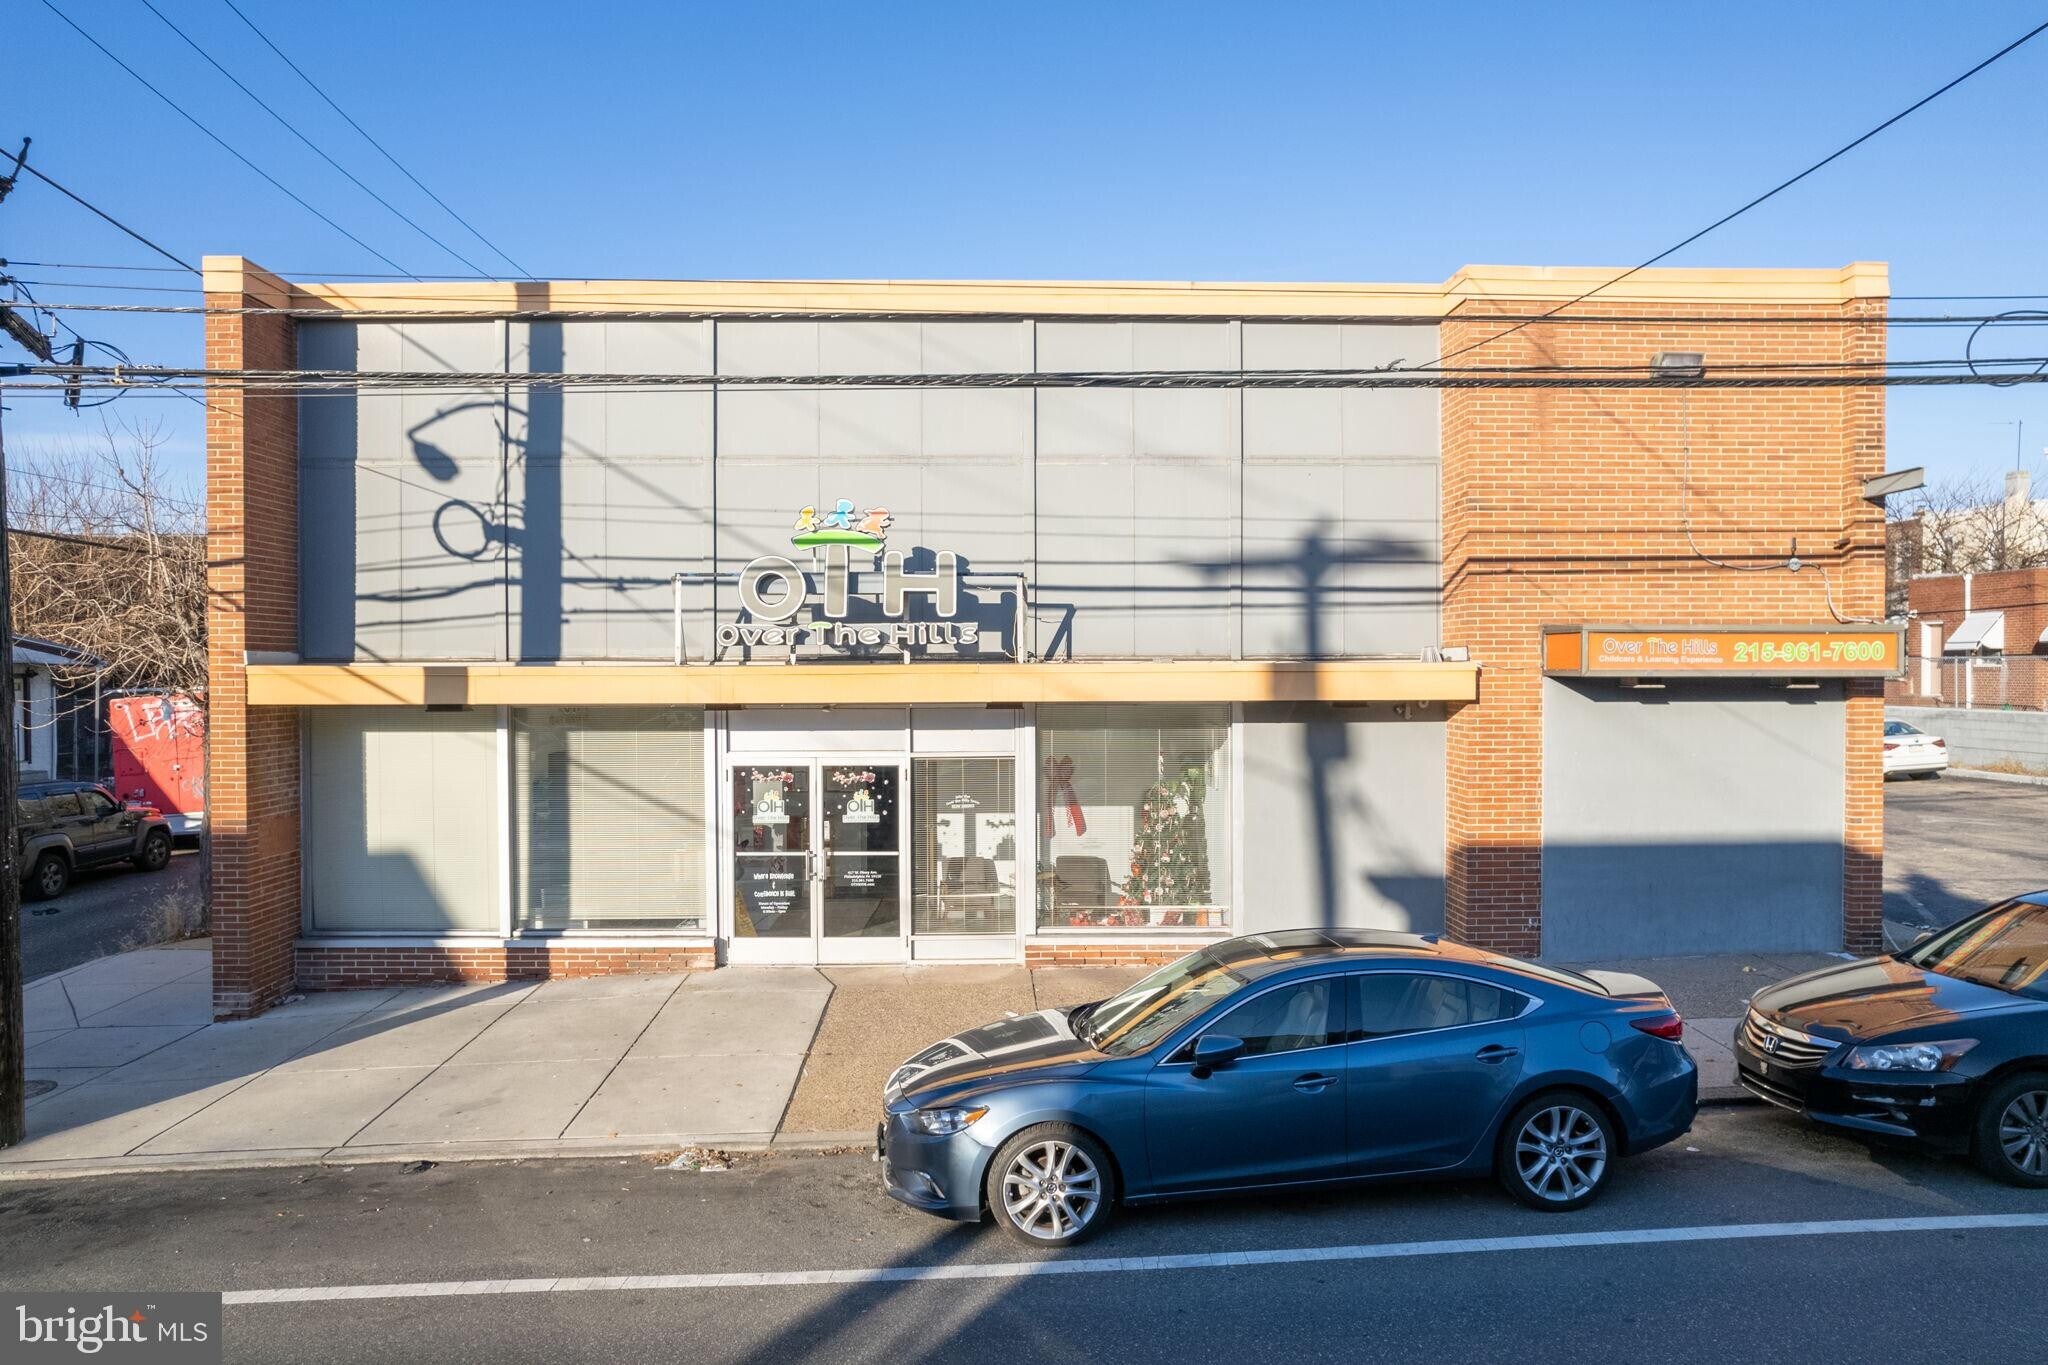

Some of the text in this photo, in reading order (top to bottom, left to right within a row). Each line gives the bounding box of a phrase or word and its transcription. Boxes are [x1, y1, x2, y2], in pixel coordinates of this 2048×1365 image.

[716, 622, 979, 646] Over The Hills
[1603, 637, 1717, 655] Over The Hills
[1733, 641, 1885, 662] 215-961-7600
[1599, 655, 1635, 663] Childcare
[1645, 656, 1679, 664] Learning
[1681, 656, 1724, 664] Experience
